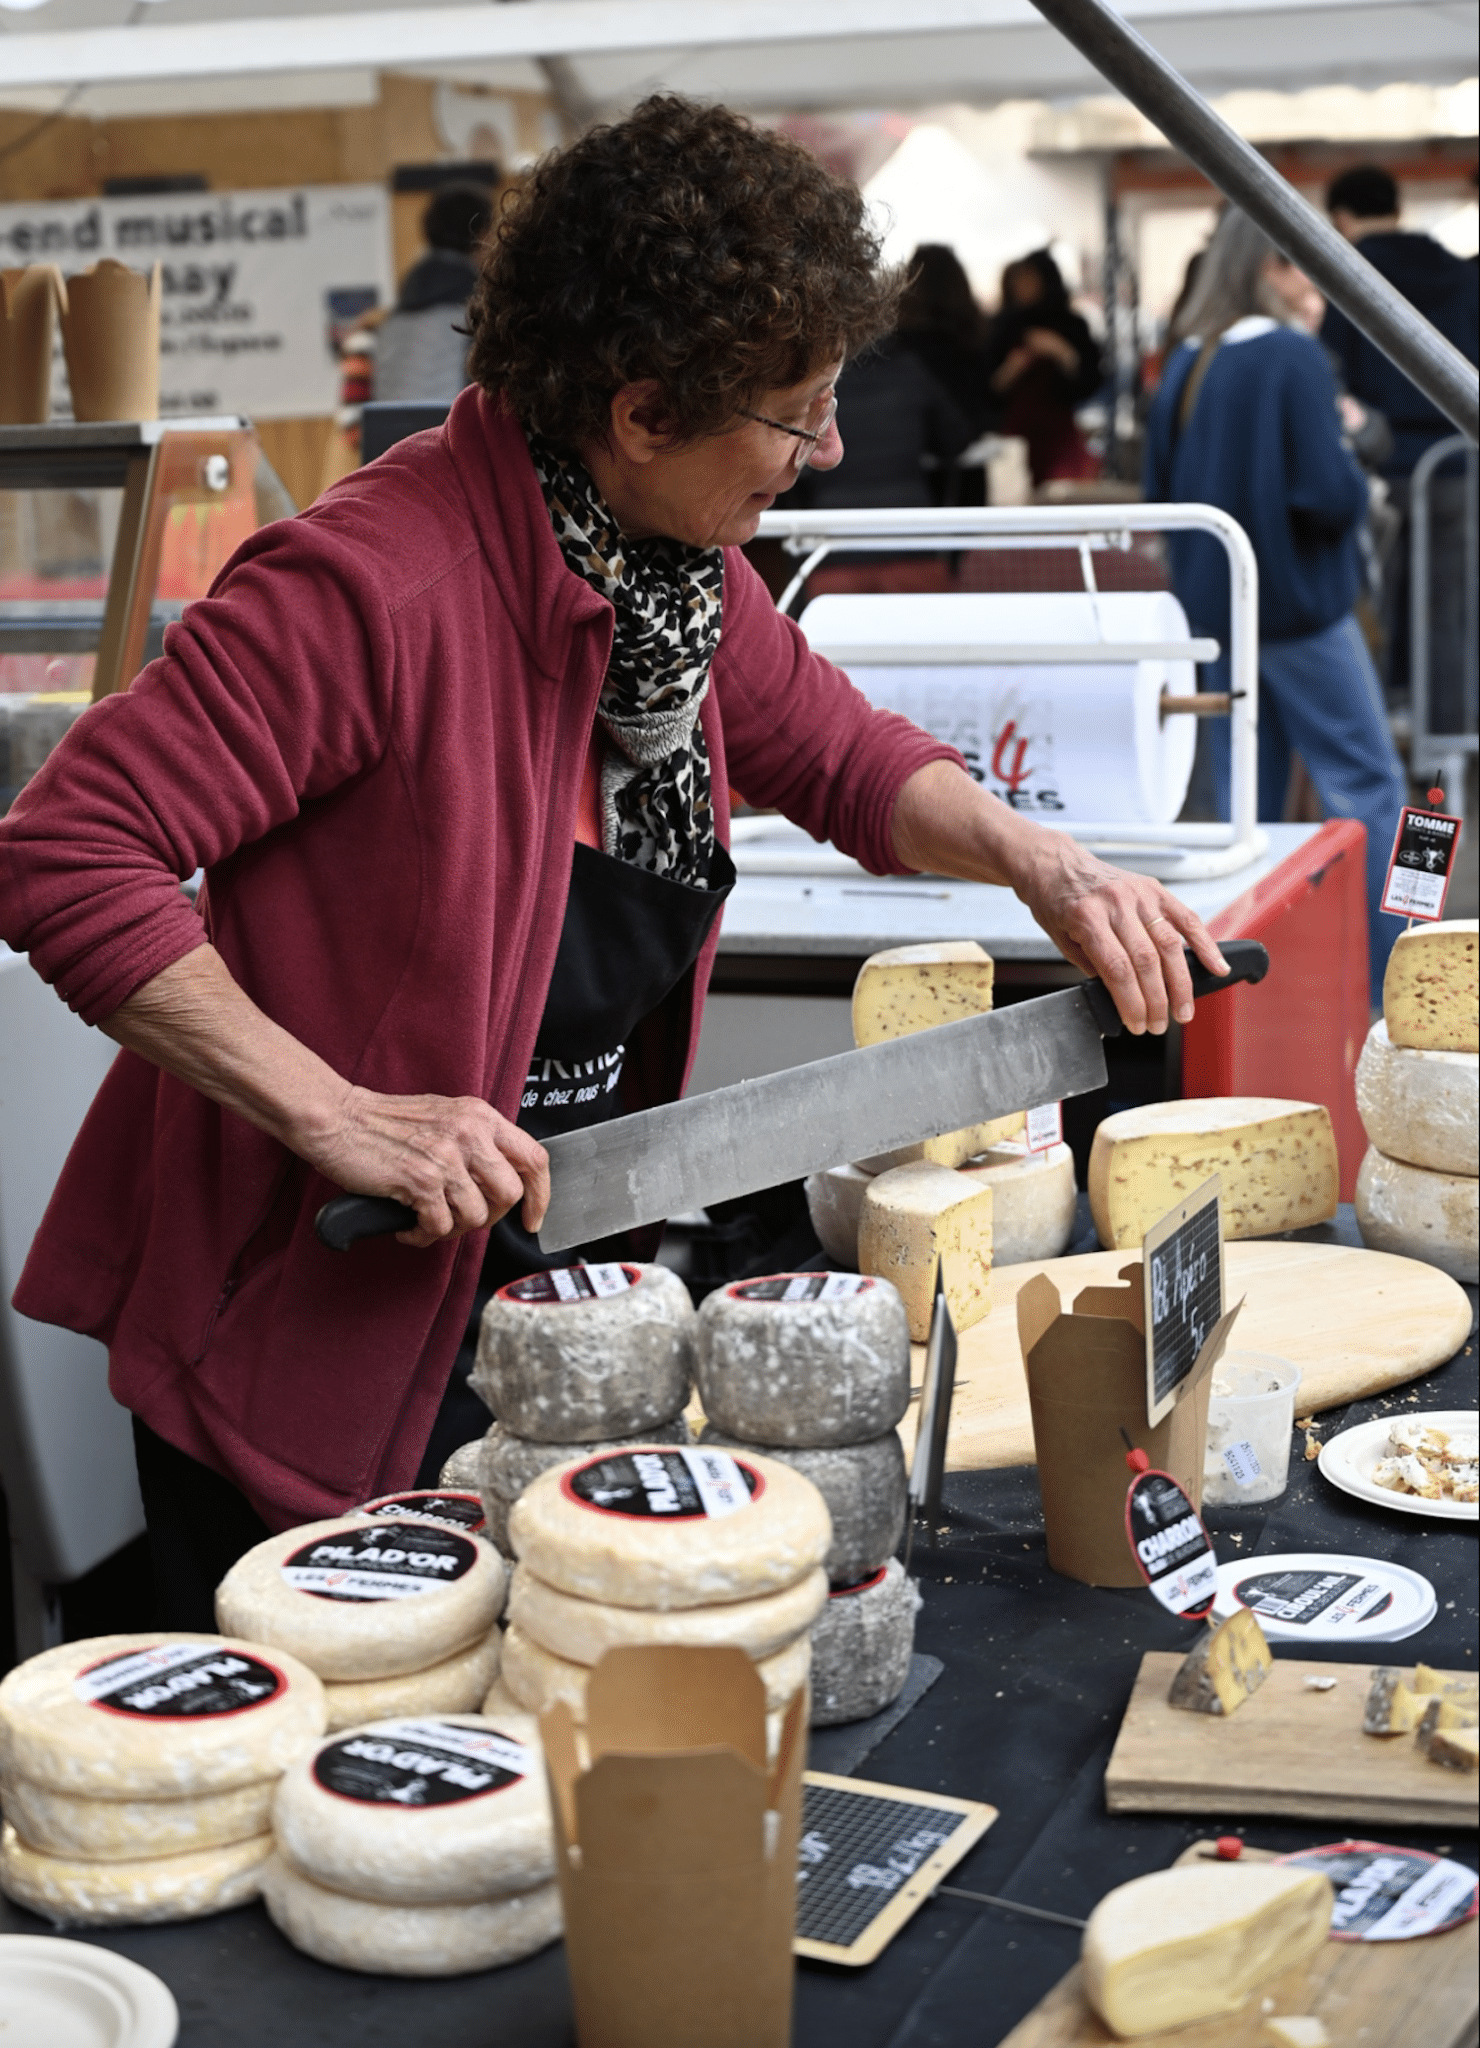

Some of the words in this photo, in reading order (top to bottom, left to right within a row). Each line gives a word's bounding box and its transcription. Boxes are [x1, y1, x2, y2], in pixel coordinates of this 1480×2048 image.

[116, 193, 306, 249] musical
[1407, 813, 1456, 835] TOMME
[520, 1089, 539, 1108] de
[543, 1088, 574, 1107] chez
[574, 1083, 600, 1103] nous
[309, 1545, 459, 1572] PILAD'OR
